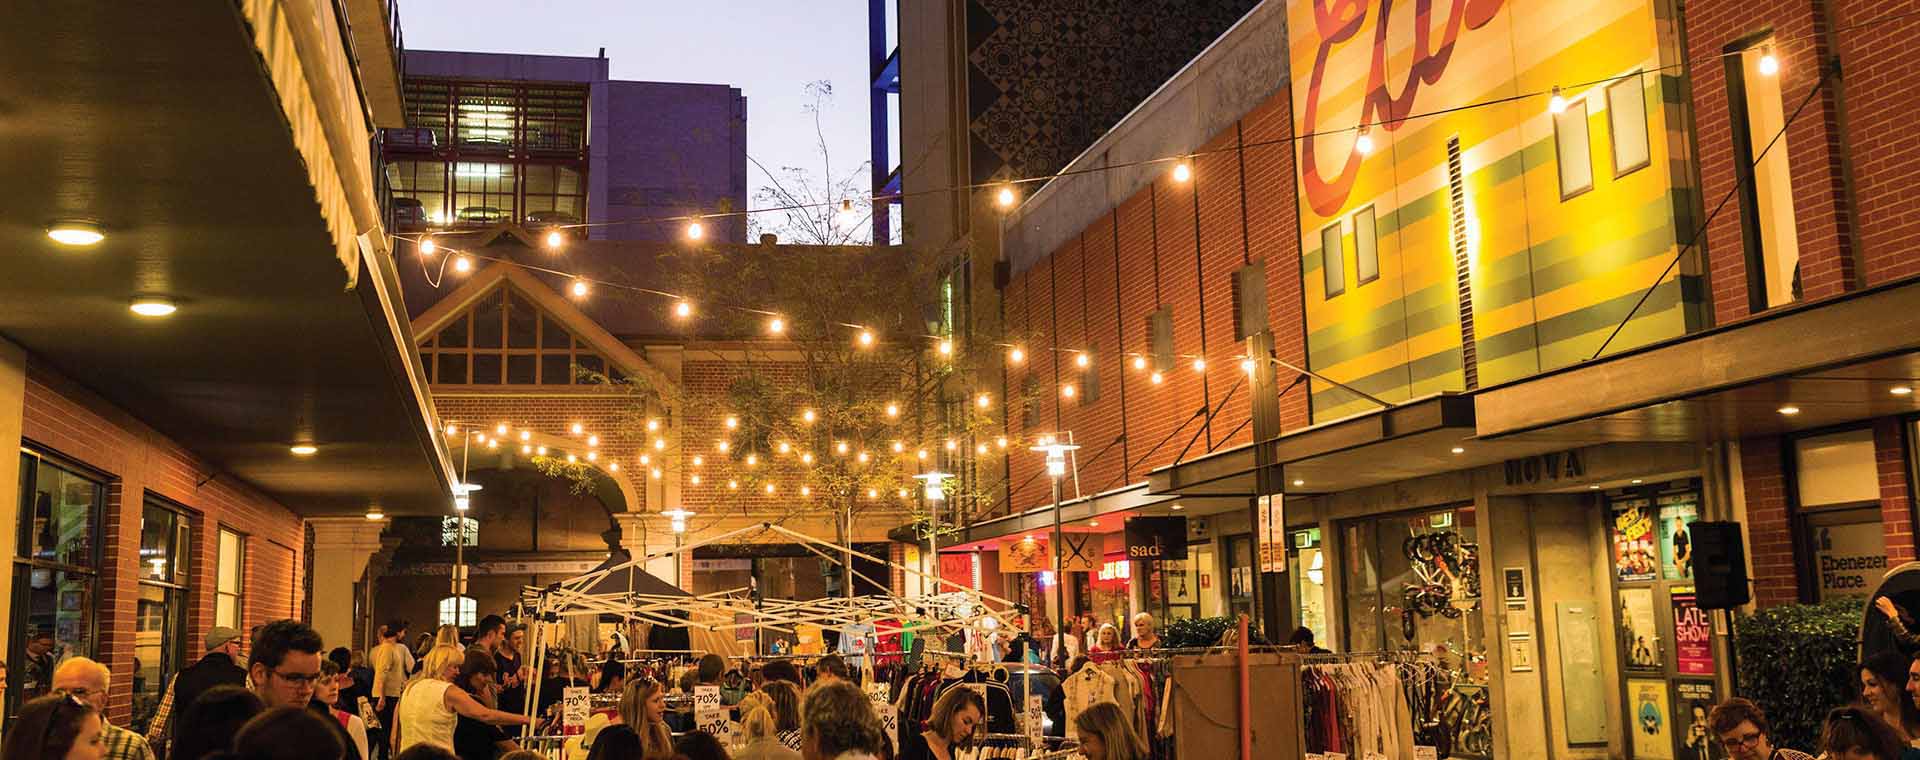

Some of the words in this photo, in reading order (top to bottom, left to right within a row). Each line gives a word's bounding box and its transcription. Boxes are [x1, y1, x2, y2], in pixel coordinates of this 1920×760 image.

[1503, 449, 1585, 486] NOVA
[1130, 536, 1160, 557] sad
[1821, 555, 1888, 571] Ebenezer
[1823, 574, 1867, 589] Place.
[1674, 607, 1710, 626] LATE
[1676, 625, 1711, 642] SHOW
[565, 695, 589, 707] 70%
[696, 693, 719, 704] 70%
[704, 712, 721, 720] TAKE
